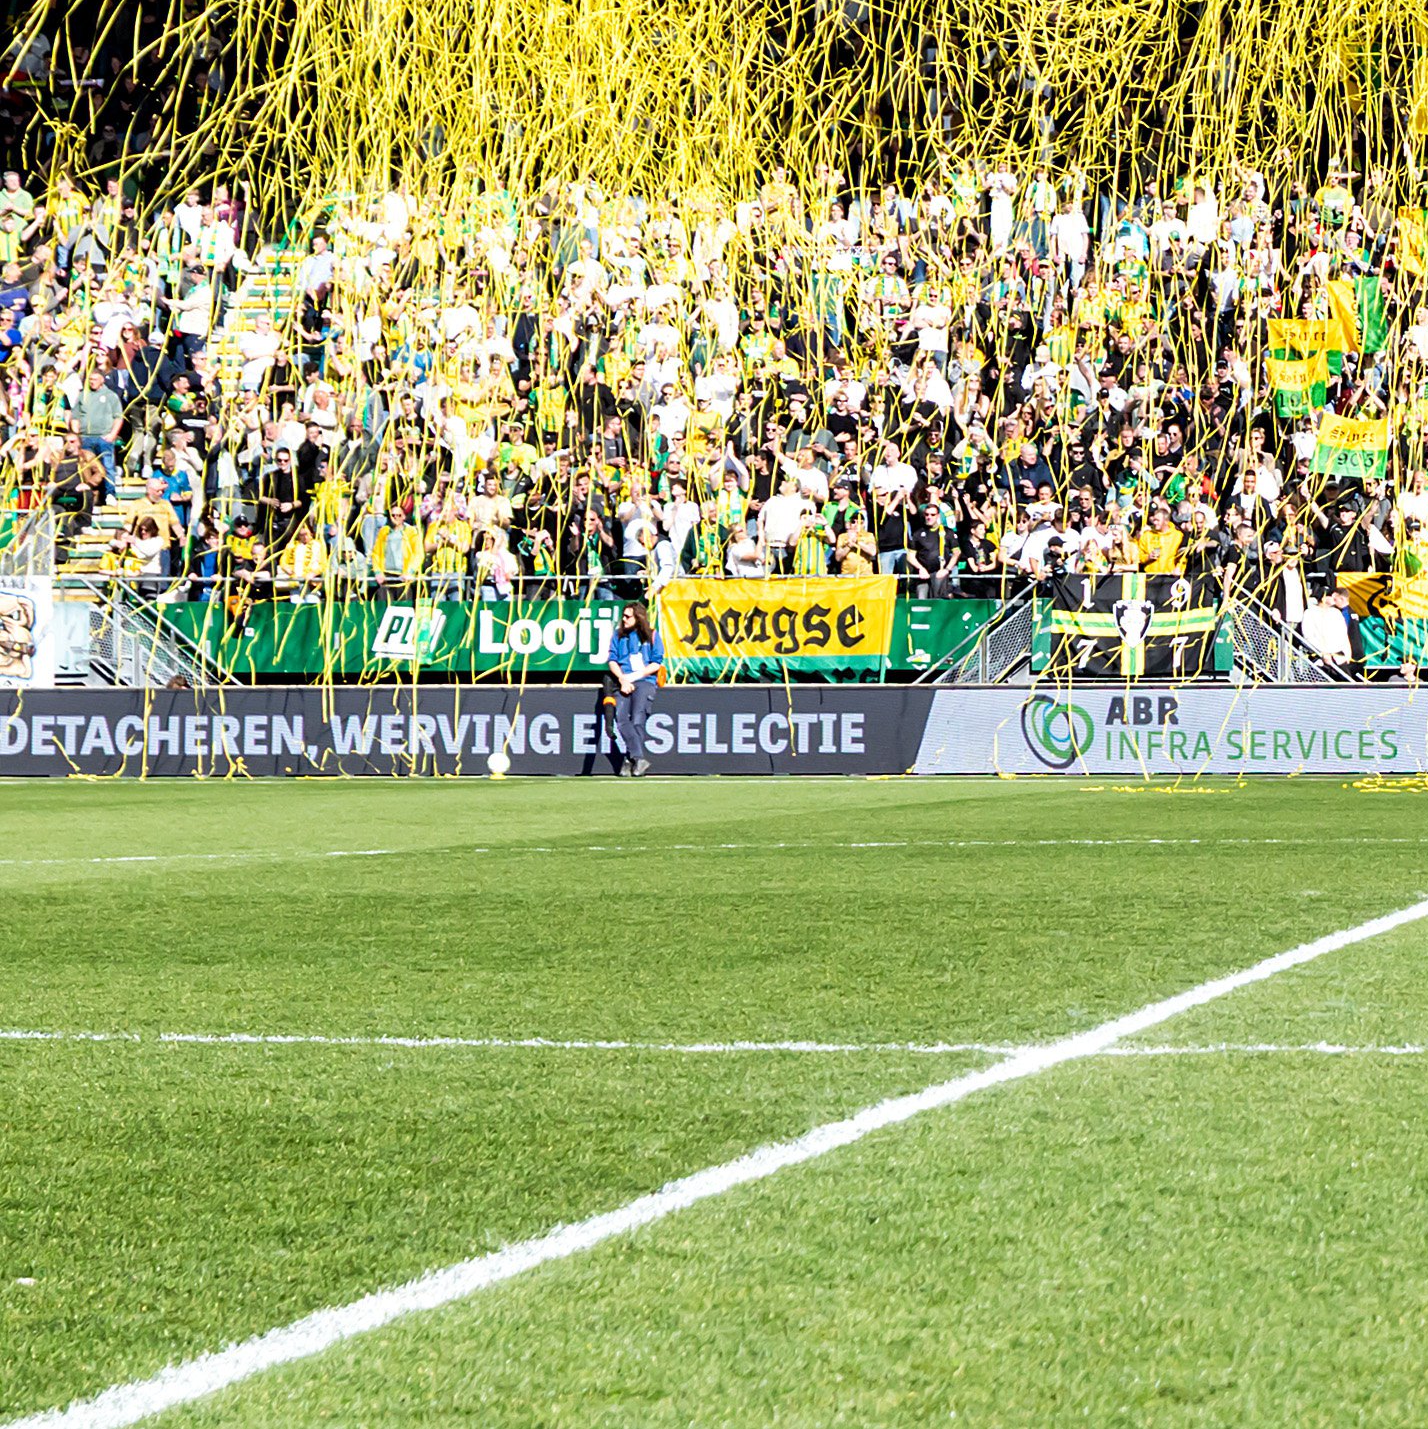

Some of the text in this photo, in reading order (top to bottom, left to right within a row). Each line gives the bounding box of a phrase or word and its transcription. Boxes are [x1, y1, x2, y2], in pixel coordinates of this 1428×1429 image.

[1333, 452, 1375, 468] 905
[1106, 697, 1178, 725] ABR
[331, 715, 561, 755] WERVING
[644, 712, 865, 754] SELECTIE
[1106, 729, 1398, 761] INFRA SERVICES
